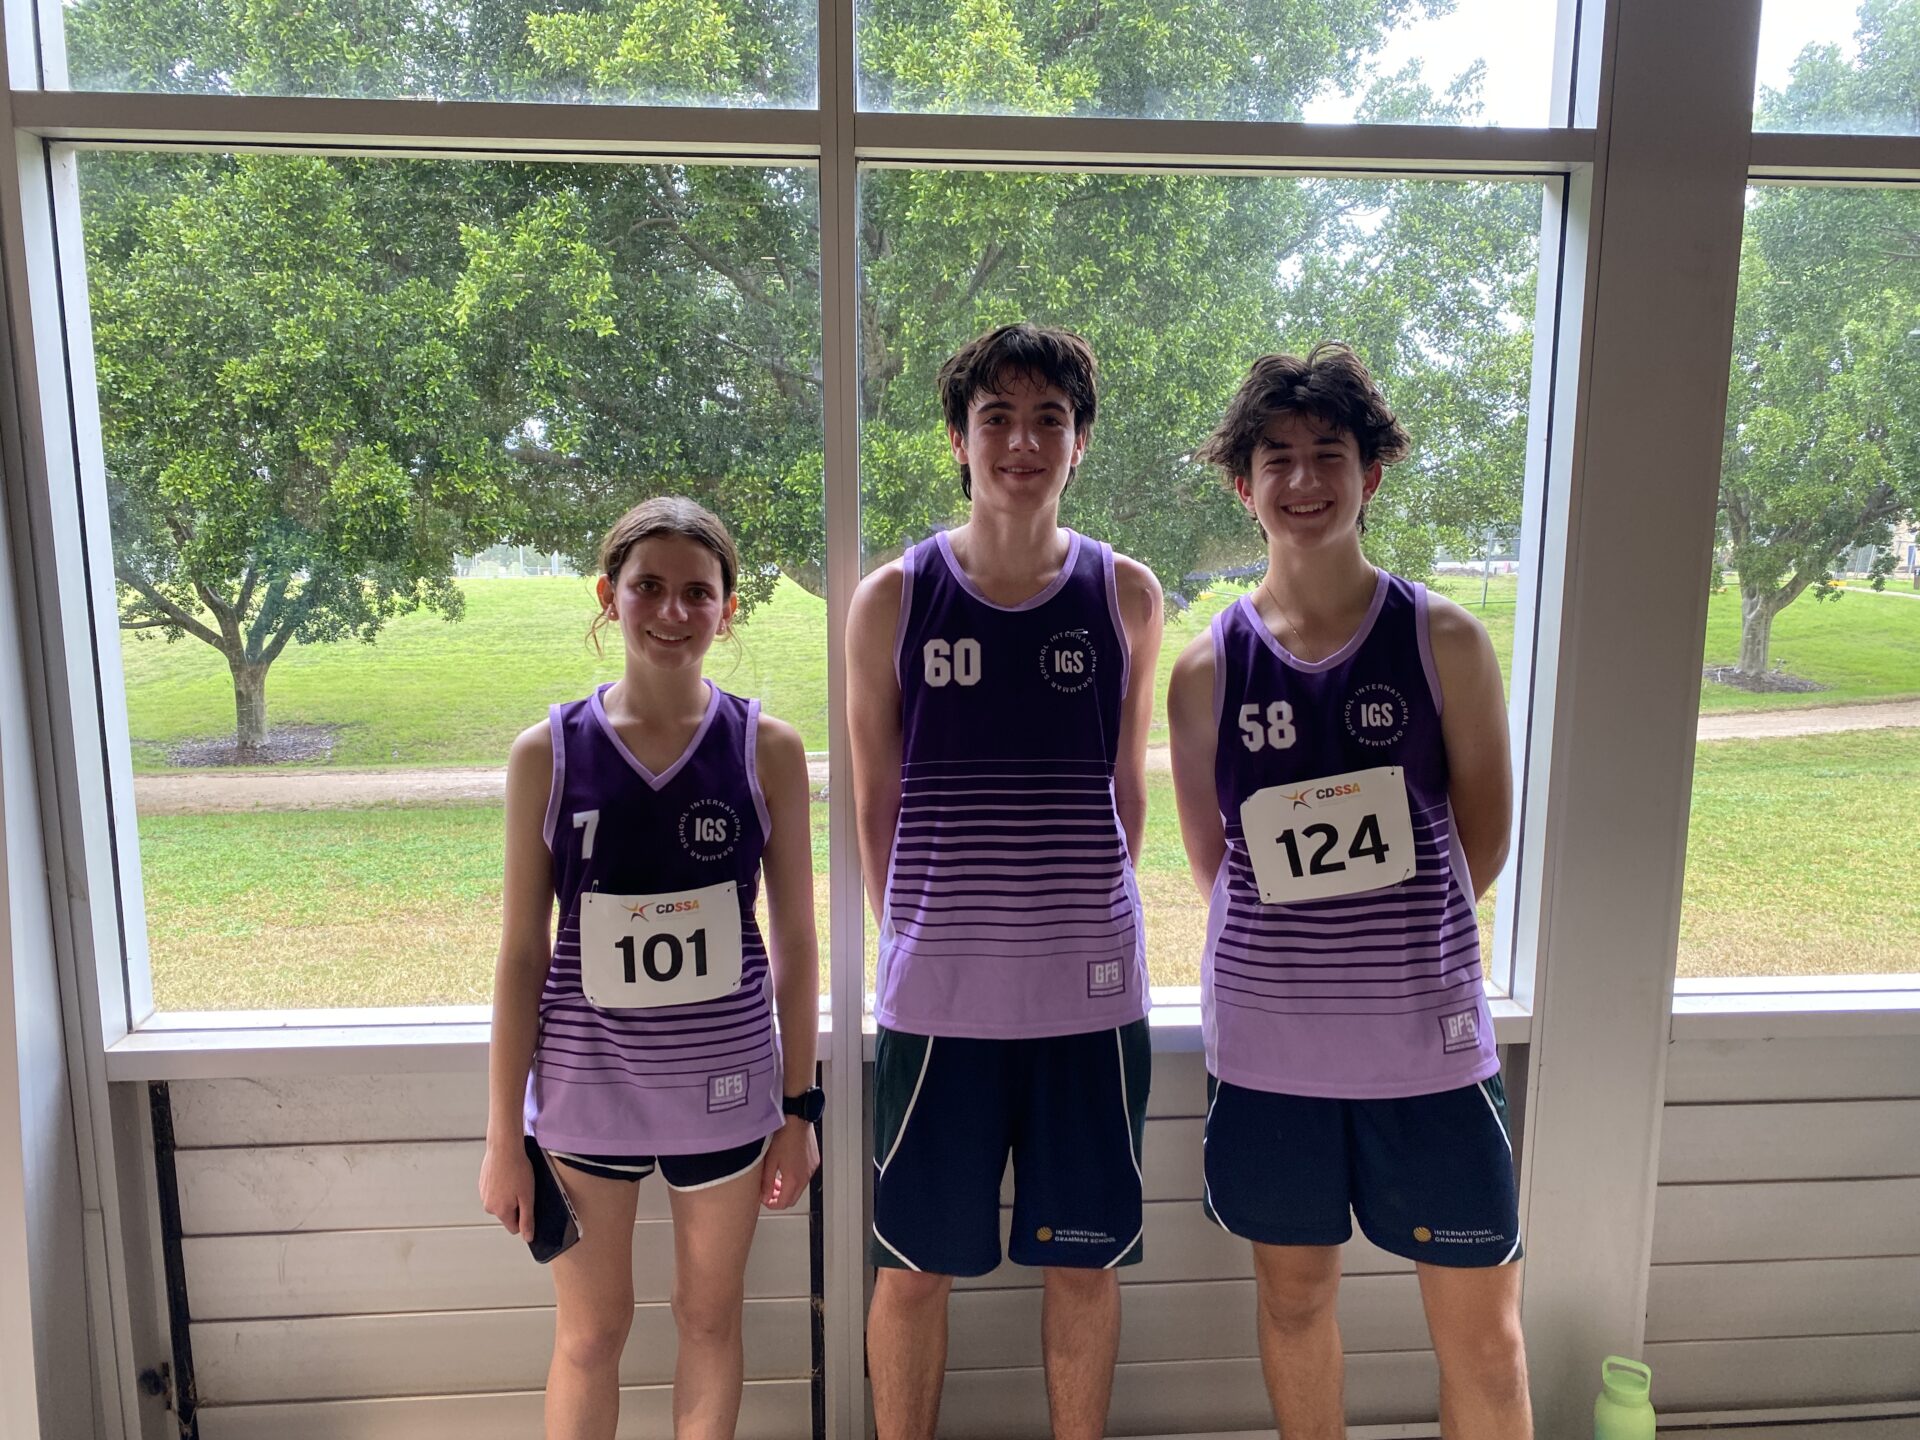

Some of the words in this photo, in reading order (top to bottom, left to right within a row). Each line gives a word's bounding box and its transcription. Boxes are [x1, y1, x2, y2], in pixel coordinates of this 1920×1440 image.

[923, 638, 982, 688] 60
[1039, 644, 1050, 680] SCHOOL
[1049, 630, 1097, 673] INTERNATIONAL
[1054, 650, 1084, 674] IGS
[1051, 676, 1093, 693] GRAMMAR
[1344, 699, 1355, 736] SCHOOL
[1354, 683, 1409, 726] INTERNATIONAL
[1360, 702, 1394, 728] IGS
[1238, 700, 1297, 753] 58
[1358, 730, 1403, 747] GRAMMAR
[1316, 782, 1361, 799] CDSSA
[572, 809, 600, 860] 7
[678, 812, 689, 849] SCHOOL
[690, 799, 741, 842] INTERNATIONAL
[695, 817, 728, 842] IGS
[690, 846, 734, 862] GRAMMAR
[1275, 813, 1390, 878] 124
[656, 899, 700, 915] CDSSA
[614, 928, 708, 983] 101
[1055, 1229, 1107, 1237] INTERNATIONAL
[1434, 1229, 1494, 1237] INTERNATIONAL
[1434, 1236, 1473, 1244] GRAMMAR
[1475, 1234, 1505, 1244] SCHOOL
